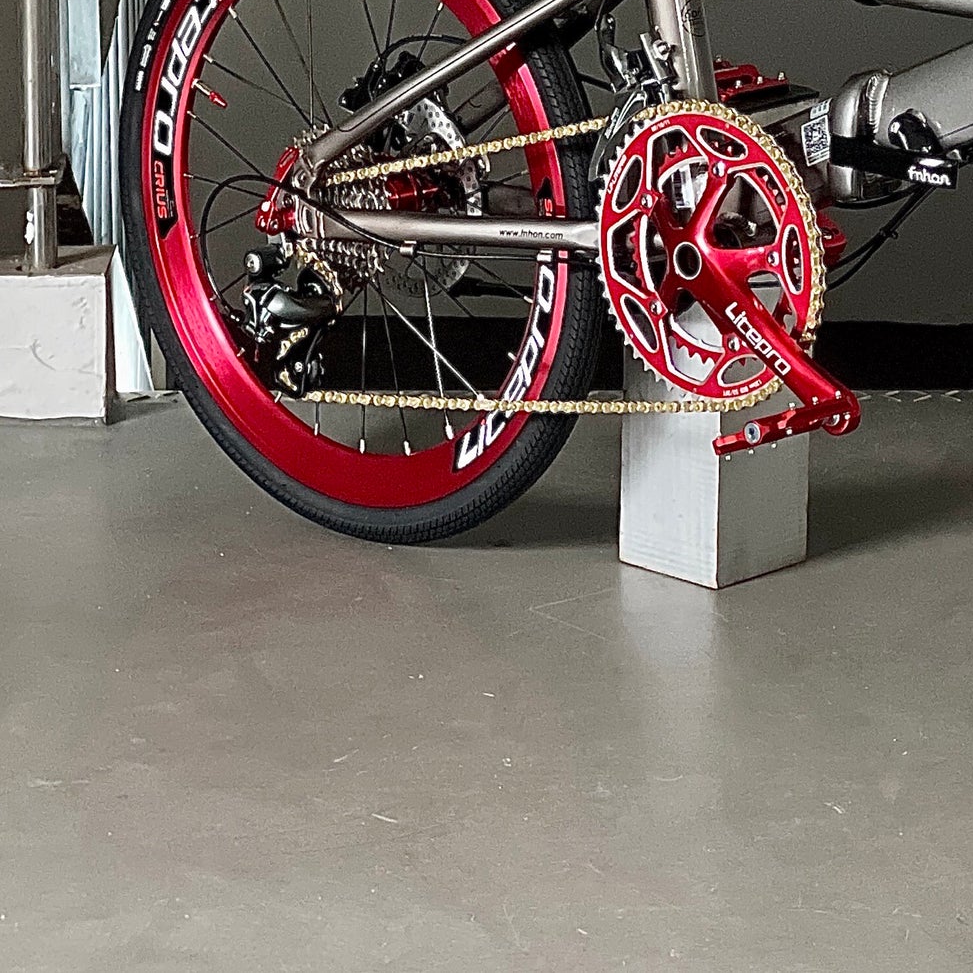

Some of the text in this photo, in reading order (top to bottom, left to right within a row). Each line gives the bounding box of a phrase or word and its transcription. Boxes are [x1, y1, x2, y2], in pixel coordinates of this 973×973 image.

[907, 165, 952, 186] fnhon
[154, 160, 168, 219] CRIUS
[499, 229, 564, 240] www.fnhon.com
